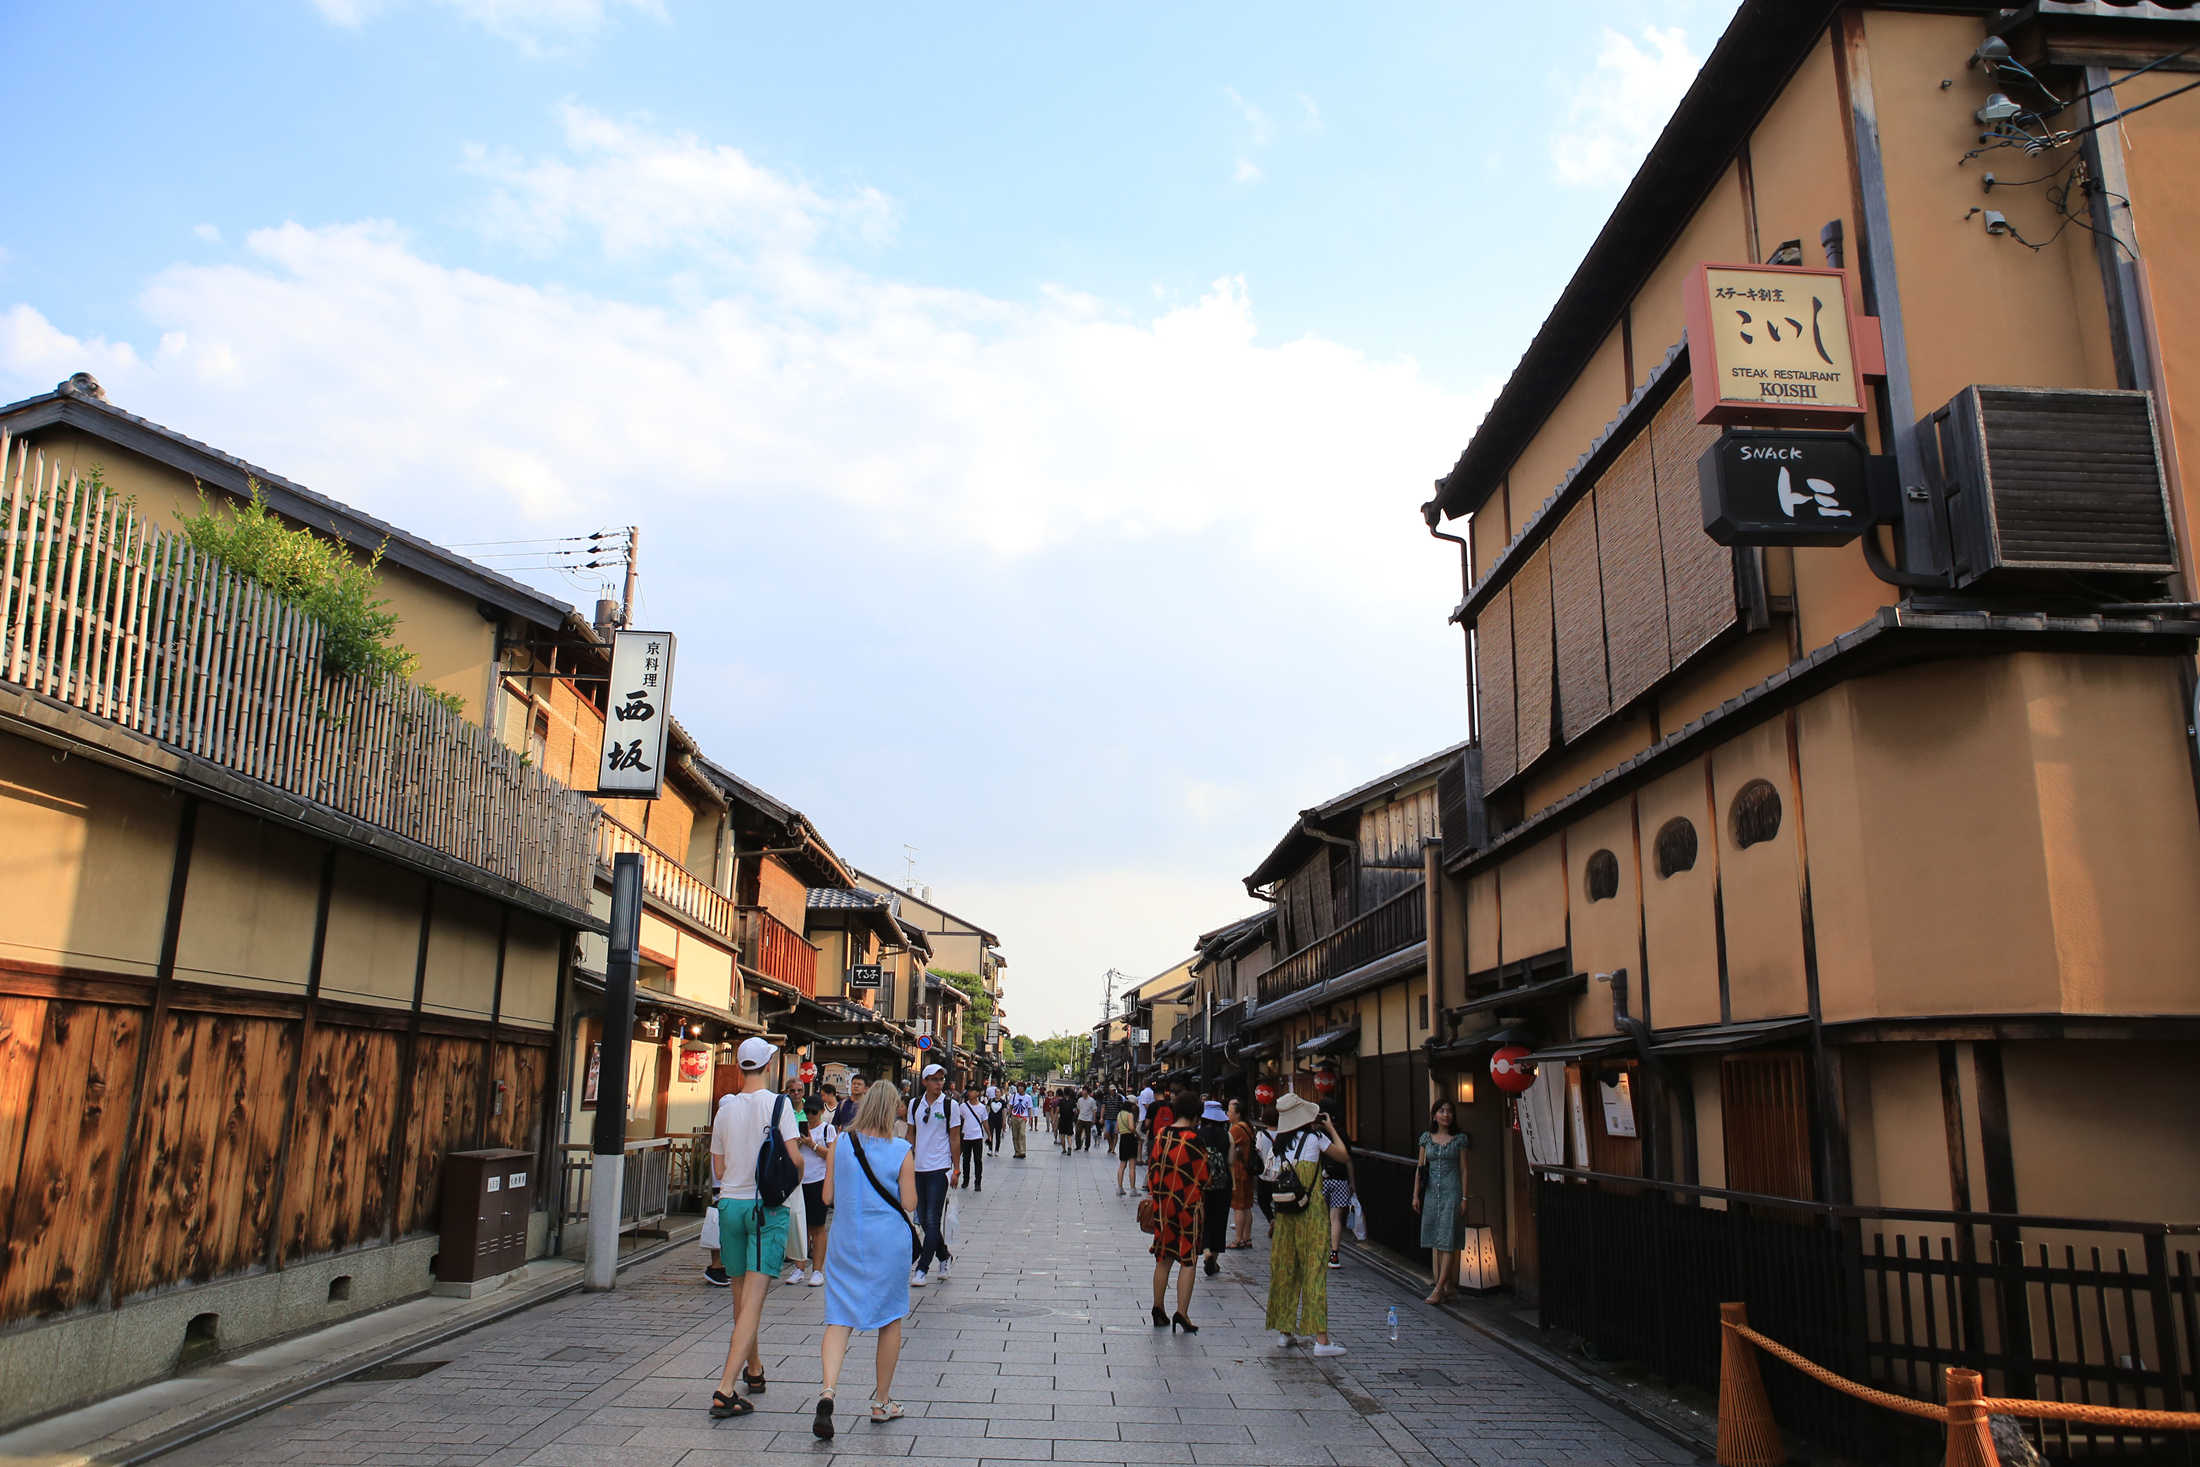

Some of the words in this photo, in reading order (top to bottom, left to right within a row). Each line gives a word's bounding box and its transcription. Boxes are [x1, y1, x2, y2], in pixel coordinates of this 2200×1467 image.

[1715, 287, 1785, 303] ステーキ割烹
[1736, 296, 1833, 365] こいし
[1732, 367, 1768, 378] STEAK
[1774, 369, 1841, 382] RESTAURANT
[1760, 382, 1818, 398] KOISHI
[1740, 446, 1803, 460] SNACK
[642, 641, 661, 688] 京料理
[607, 689, 655, 772] 西坂
